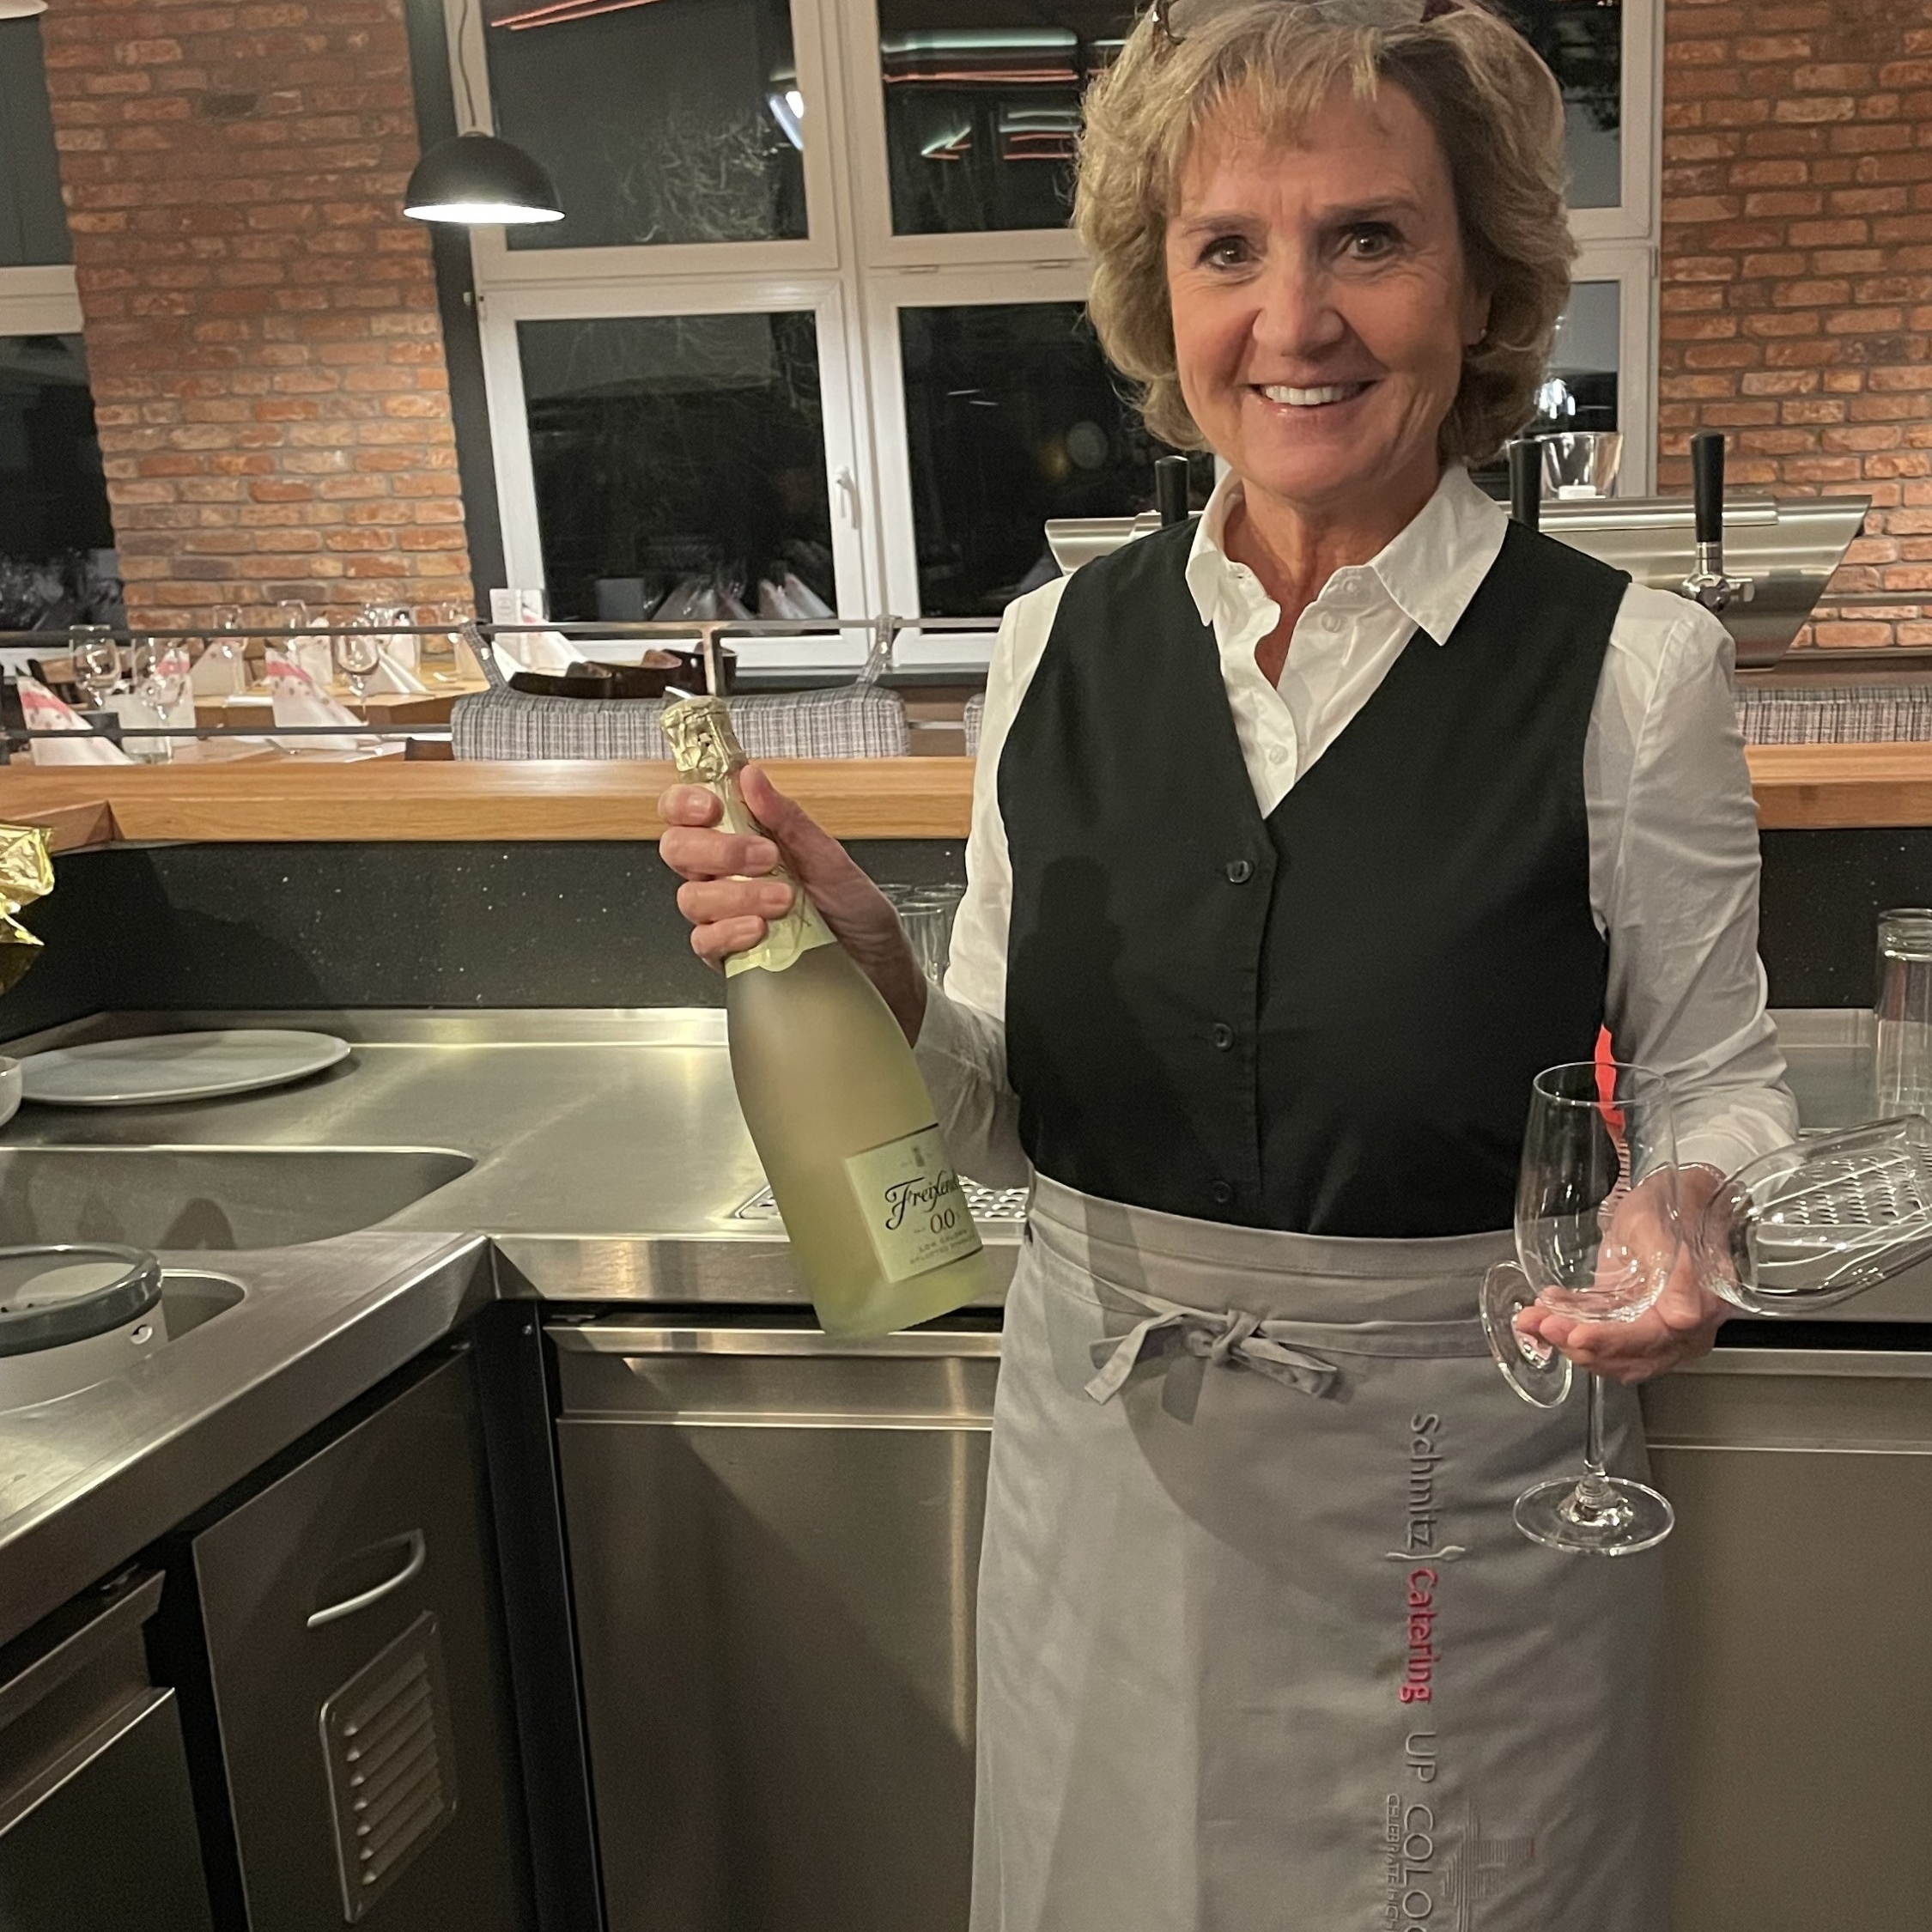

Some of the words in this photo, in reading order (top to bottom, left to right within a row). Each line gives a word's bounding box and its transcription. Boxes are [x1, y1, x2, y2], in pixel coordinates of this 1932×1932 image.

[1407, 1413, 1443, 1549] Schmitz
[1399, 1568, 1442, 1704] Catering
[1406, 1731, 1437, 1783] UP
[1402, 1804, 1434, 1932] COLO
